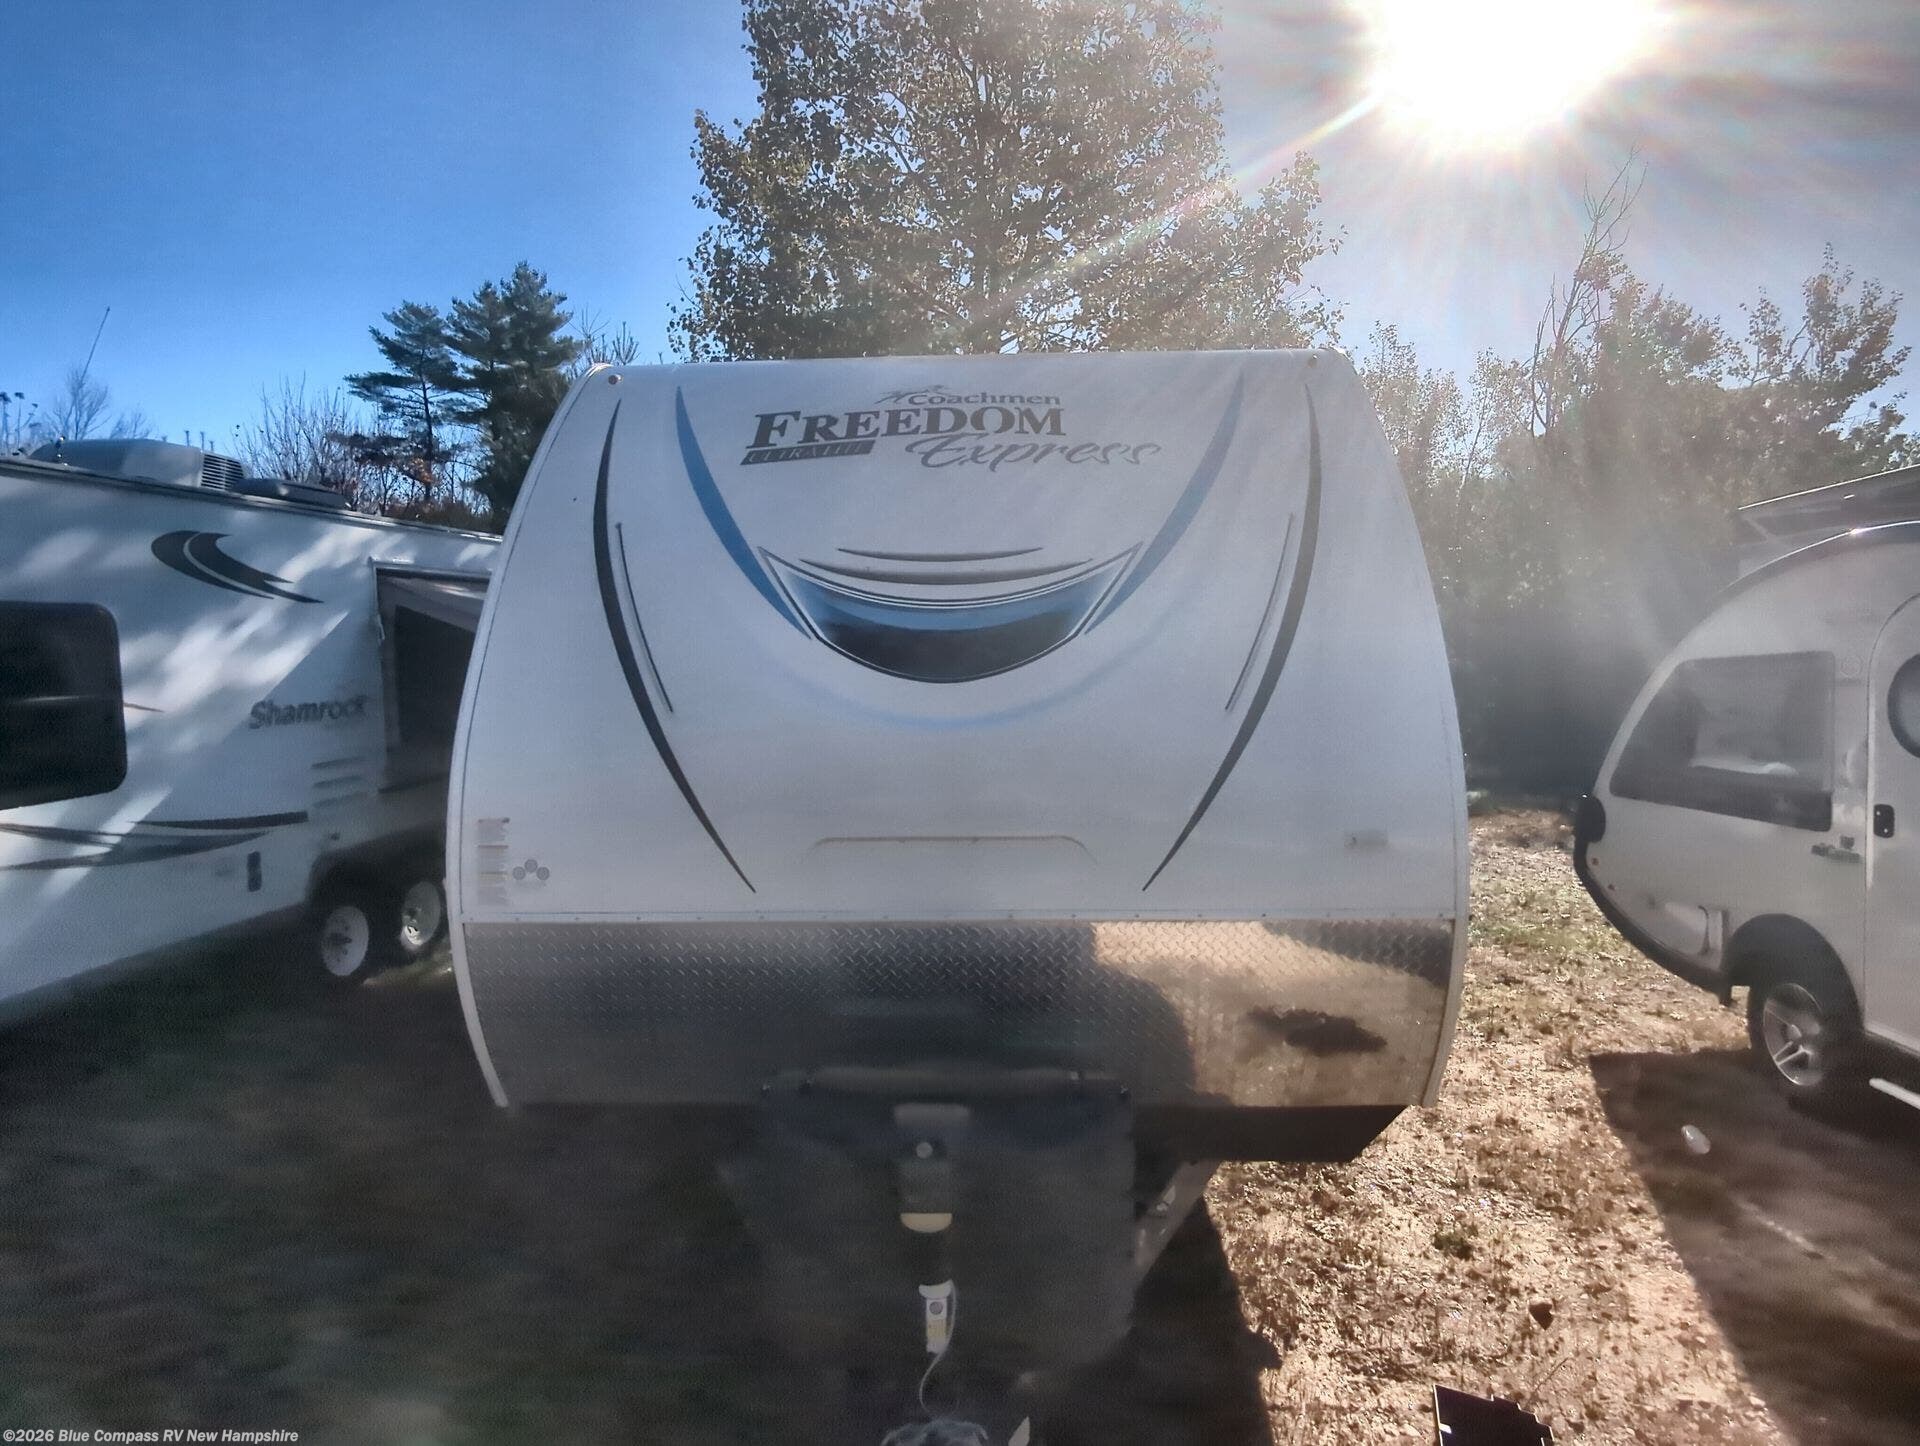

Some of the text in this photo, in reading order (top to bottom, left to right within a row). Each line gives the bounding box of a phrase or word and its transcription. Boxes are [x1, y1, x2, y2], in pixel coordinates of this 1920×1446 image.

[908, 391, 1061, 406] Coachmen
[746, 406, 1067, 450] FREEDOM
[905, 432, 1162, 473] Express
